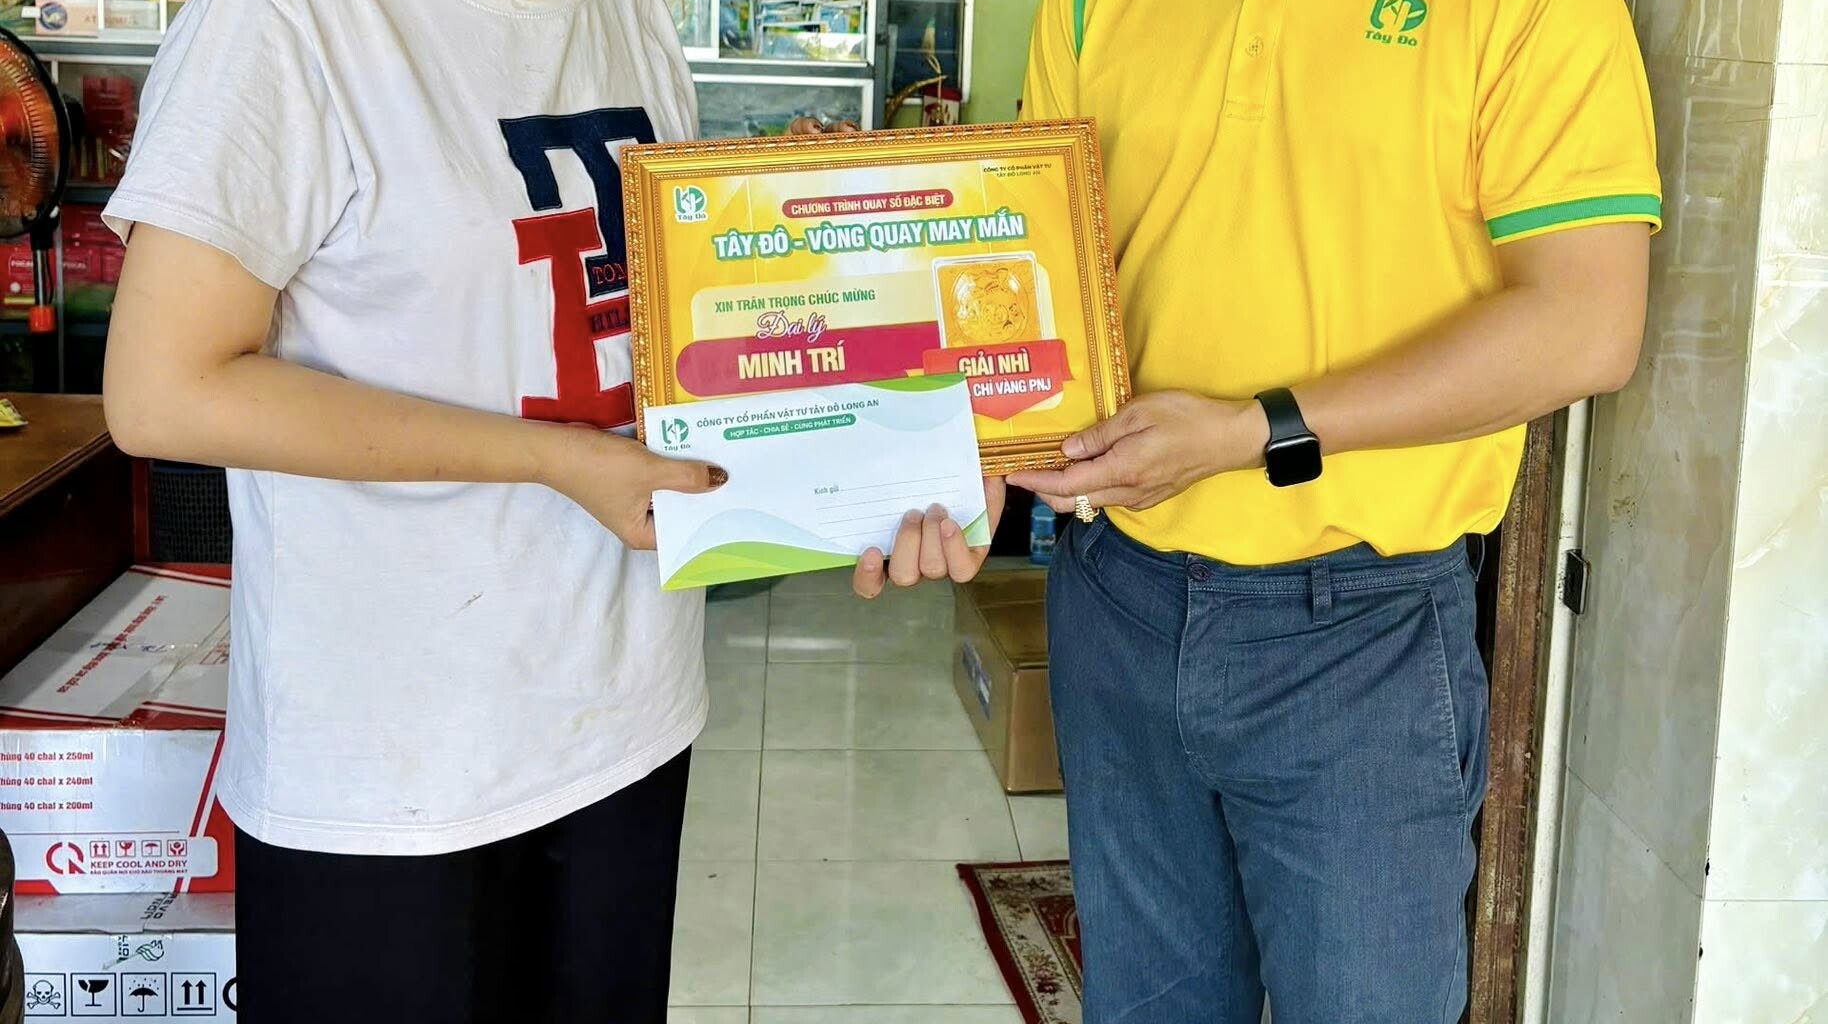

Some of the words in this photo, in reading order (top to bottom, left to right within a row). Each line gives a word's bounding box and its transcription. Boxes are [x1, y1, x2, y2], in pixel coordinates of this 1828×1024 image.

[792, 202, 831, 215] CHƯƠNG
[832, 199, 861, 213] TRÌNH
[863, 198, 887, 210] QUAY
[888, 194, 902, 208] SỐ
[904, 196, 923, 208] ĐẶC
[924, 194, 945, 207] BIỆT
[714, 230, 754, 258] TÂY
[758, 228, 790, 254] ĐÔ
[806, 222, 866, 251] VÒNG
[870, 222, 923, 248] QUAY
[929, 218, 976, 242] MAY
[978, 209, 1025, 239] MẮN
[714, 301, 734, 313] XIN
[736, 296, 766, 310] TRÂN
[769, 294, 806, 310] TRỌNG
[808, 290, 840, 306] CHÚC
[842, 288, 876, 303] MỪNG
[756, 310, 803, 339] Đại
[806, 312, 827, 343] lý
[737, 349, 804, 380] MINH
[806, 339, 846, 373] TRÍ
[958, 350, 994, 376] GIẢI
[998, 348, 1030, 374] NHÌ
[994, 378, 1027, 396] VÀNG
[1029, 378, 1052, 392] PNJ
[696, 417, 722, 428] CÔNG
[723, 416, 735, 425] TY
[736, 410, 749, 424] CỔ
[750, 409, 776, 422] PHẦN
[776, 409, 794, 421] VẬT
[796, 407, 808, 416] TƯ
[808, 404, 826, 416] TÂY
[826, 402, 840, 413] ĐÔ
[841, 400, 866, 412] LONG
[866, 399, 880, 408] AN
[746, 427, 760, 436] TÁC
[763, 426, 780, 434] CHIA
[24, 752, 35, 760] 40
[37, 752, 56, 760] chai
[66, 752, 94, 760] 250ml
[24, 777, 35, 786] 40
[37, 776, 56, 786] chai
[66, 776, 94, 786] 240ml
[24, 802, 35, 810] 40
[37, 802, 56, 810] chai
[66, 802, 94, 810] 200ml
[90, 860, 114, 868] KEEP
